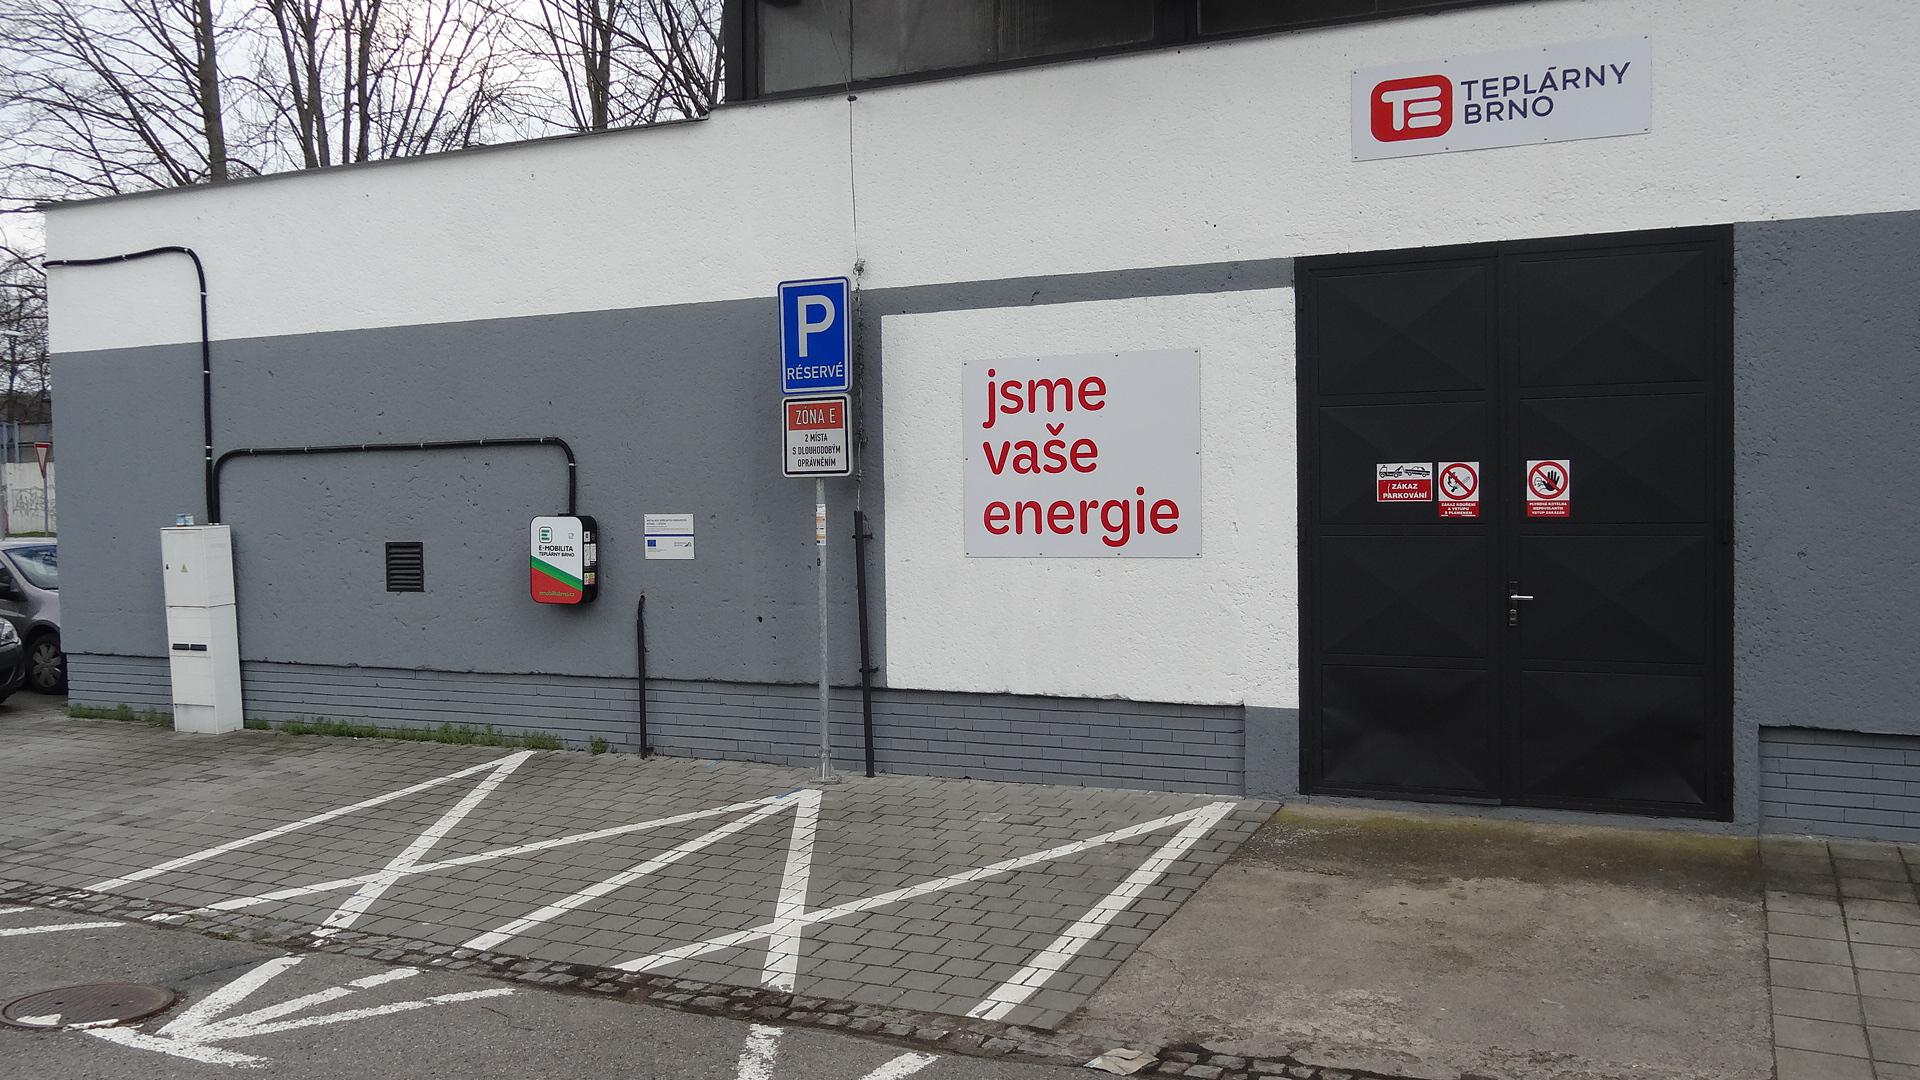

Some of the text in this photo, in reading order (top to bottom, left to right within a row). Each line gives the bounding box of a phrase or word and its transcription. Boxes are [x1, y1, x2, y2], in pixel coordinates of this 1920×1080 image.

[1461, 61, 1631, 100] TEPLÁRNY
[1464, 95, 1554, 124] BRNO
[797, 294, 836, 358] P
[787, 361, 843, 381] RÉSERVÉ
[982, 368, 1107, 429] jsme
[796, 405, 836, 425] ZÓNA E
[804, 431, 828, 443] 2 MÍSTA
[792, 443, 841, 455] S DLOUHODOBÝM
[982, 422, 1098, 475] vaše
[797, 456, 836, 467] OPRÁVNĚNÍM
[1382, 490, 1428, 499] PARKOVÁNÍ
[1391, 481, 1418, 490] ZÁKAZ
[983, 486, 1180, 547] energie
